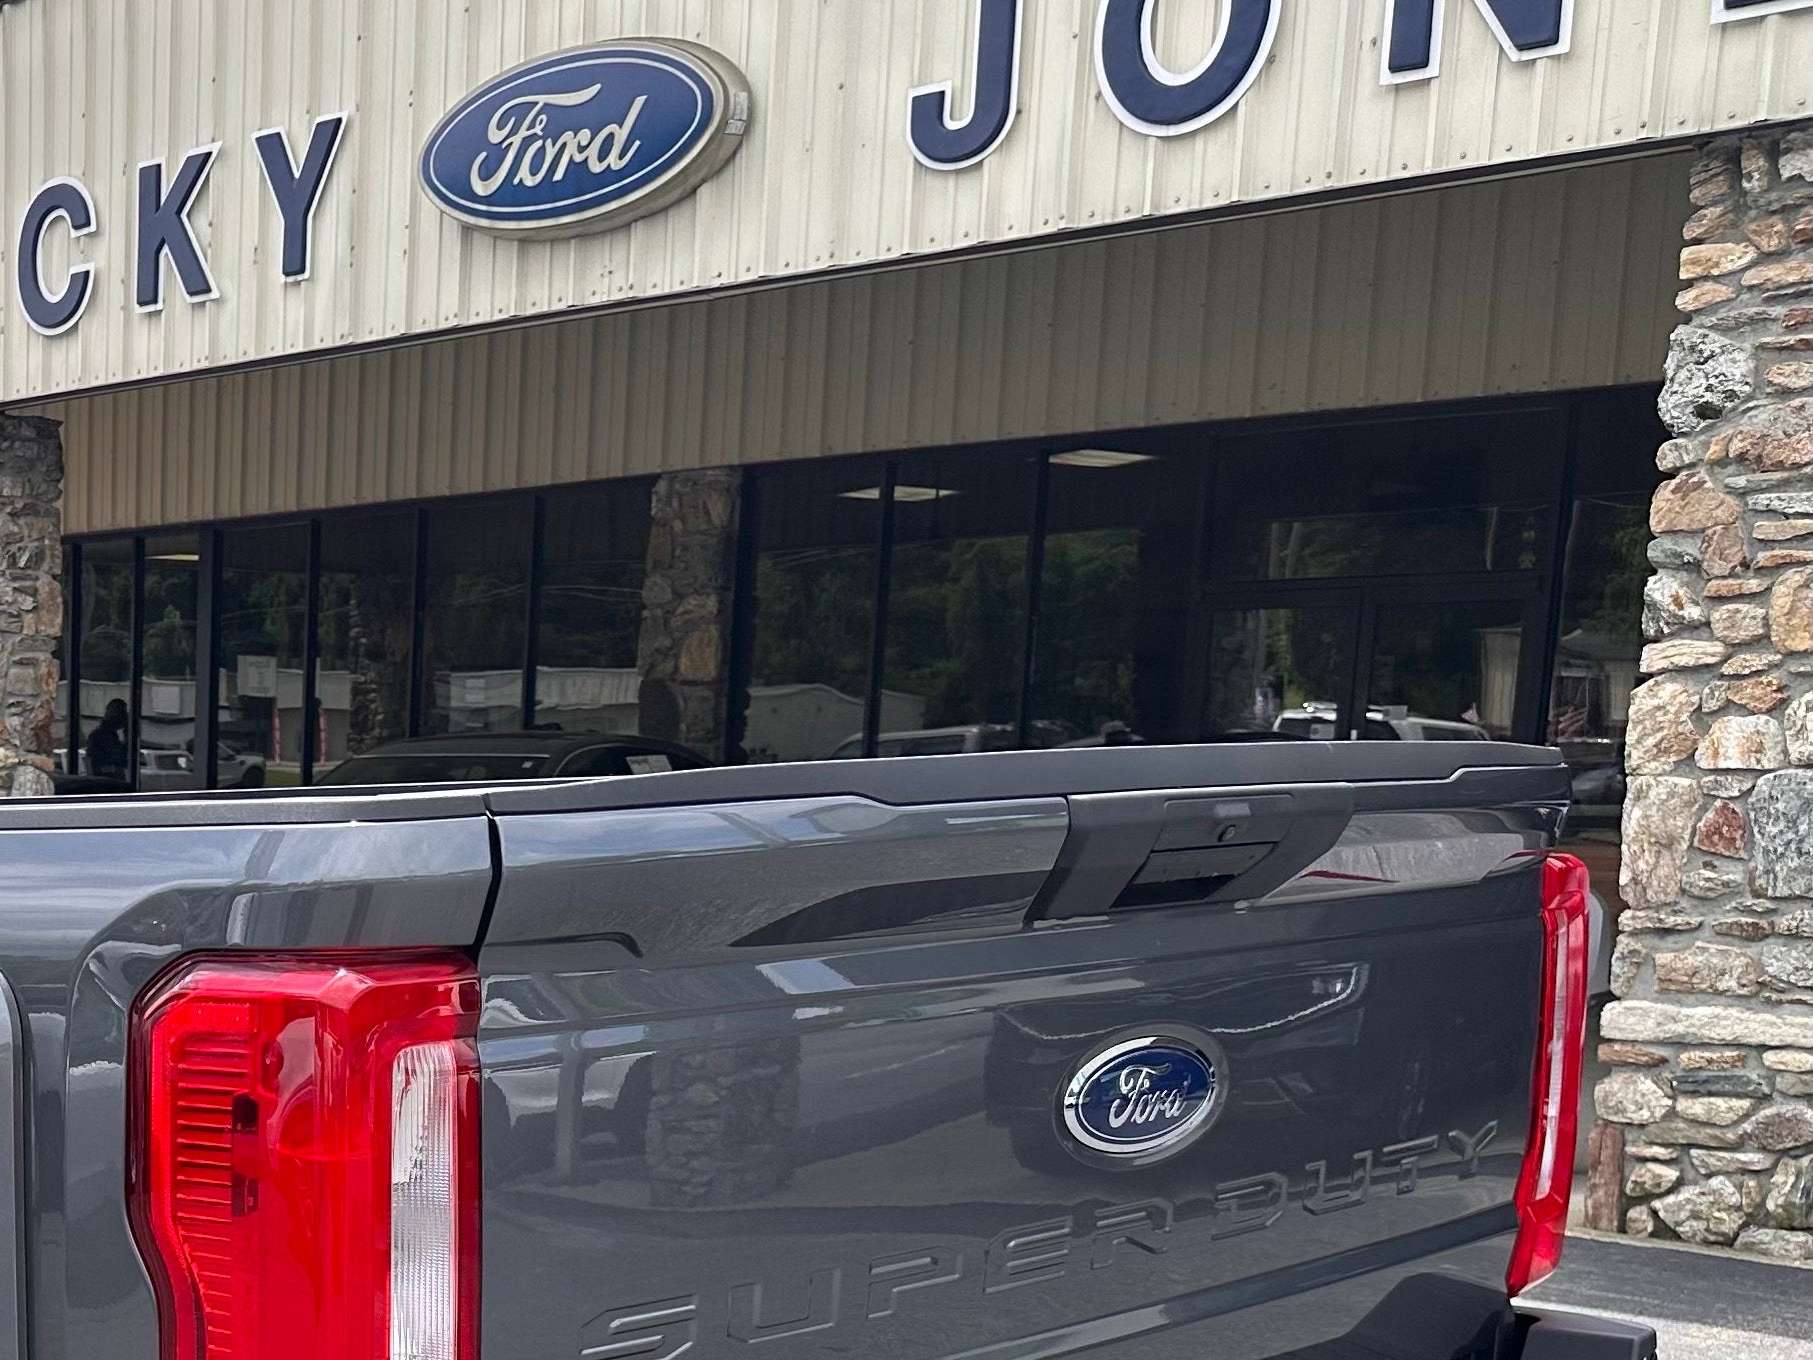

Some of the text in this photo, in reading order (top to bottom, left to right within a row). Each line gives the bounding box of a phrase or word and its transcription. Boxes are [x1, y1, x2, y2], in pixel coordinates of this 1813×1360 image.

[469, 83, 648, 198] Ford
[906, 0, 1813, 170] JO
[1108, 1062, 1192, 1129] Ford
[1209, 1119, 1500, 1241] DUTY
